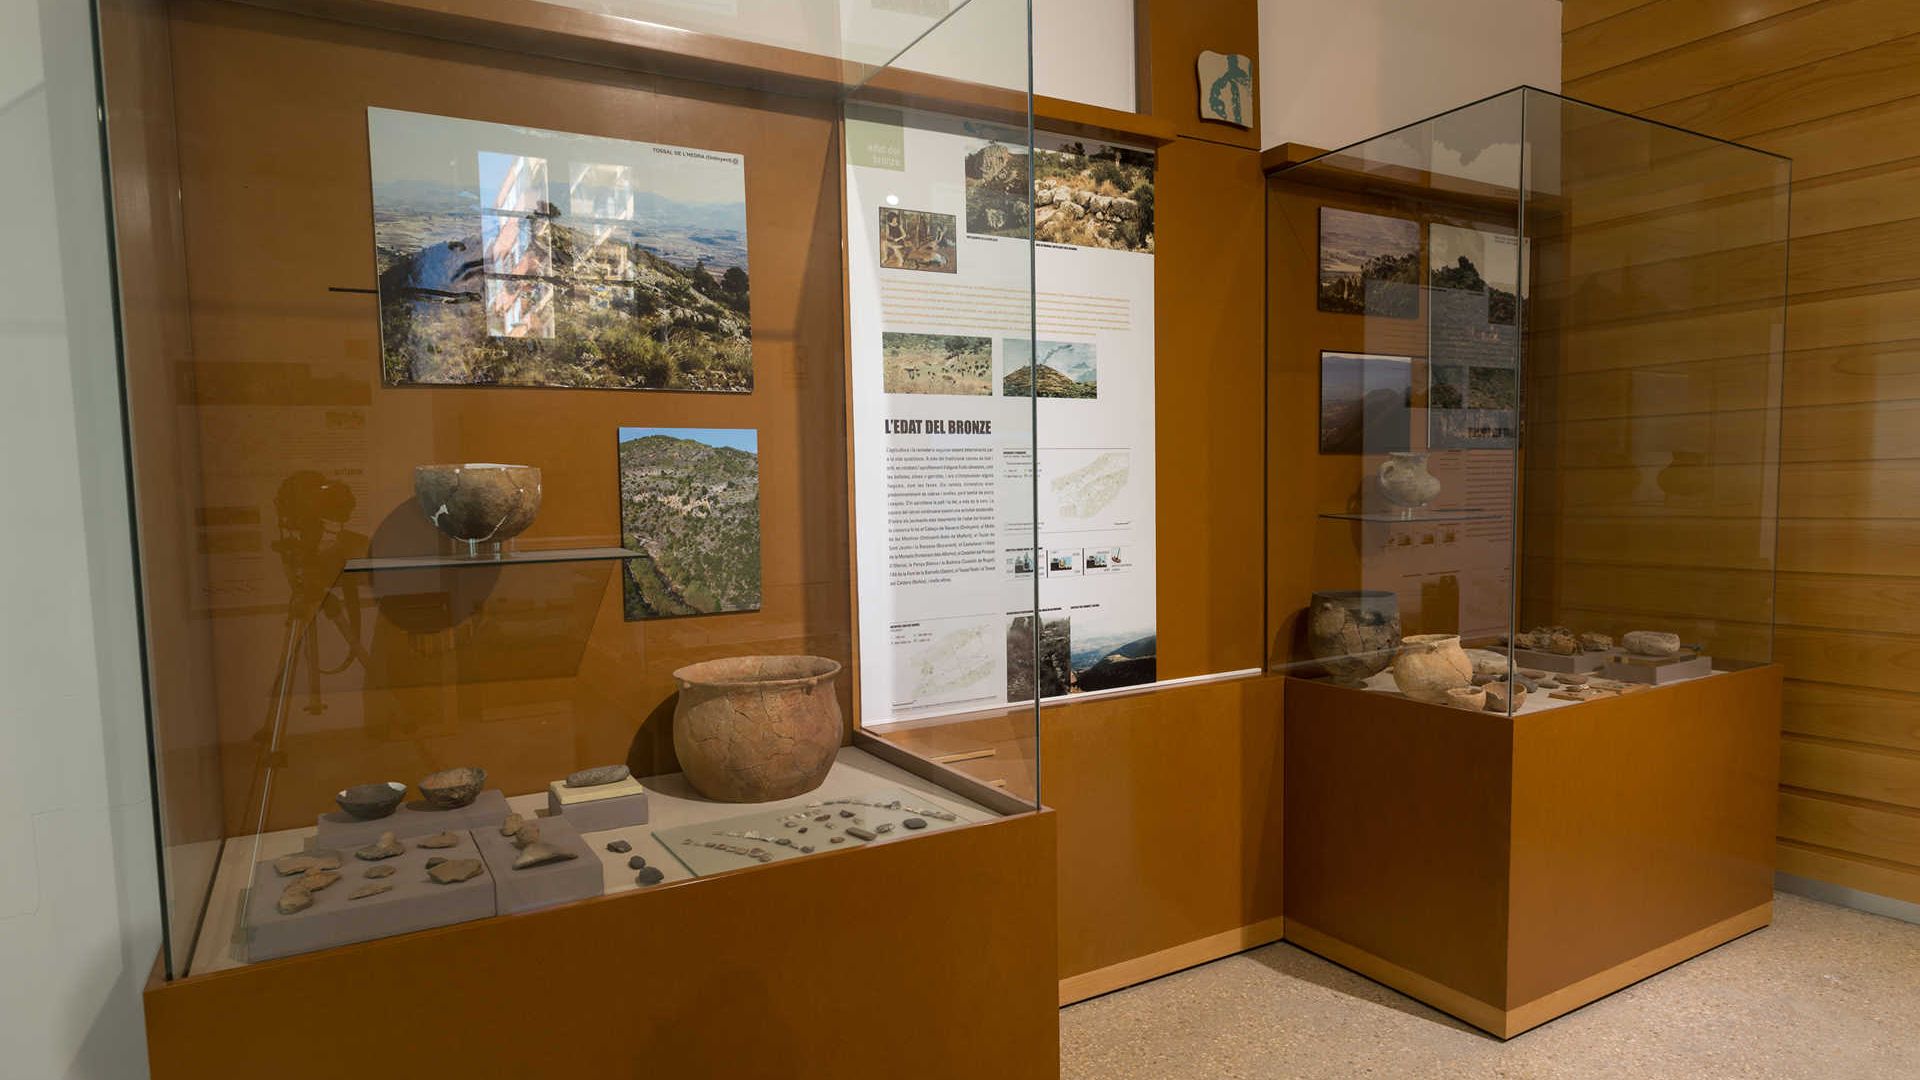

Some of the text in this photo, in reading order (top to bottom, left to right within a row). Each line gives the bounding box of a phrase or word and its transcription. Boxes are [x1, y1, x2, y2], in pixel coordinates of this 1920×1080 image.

[652, 147, 672, 155] TOSSAL
[885, 419, 992, 435] L'EDAT DEL BRONZE
